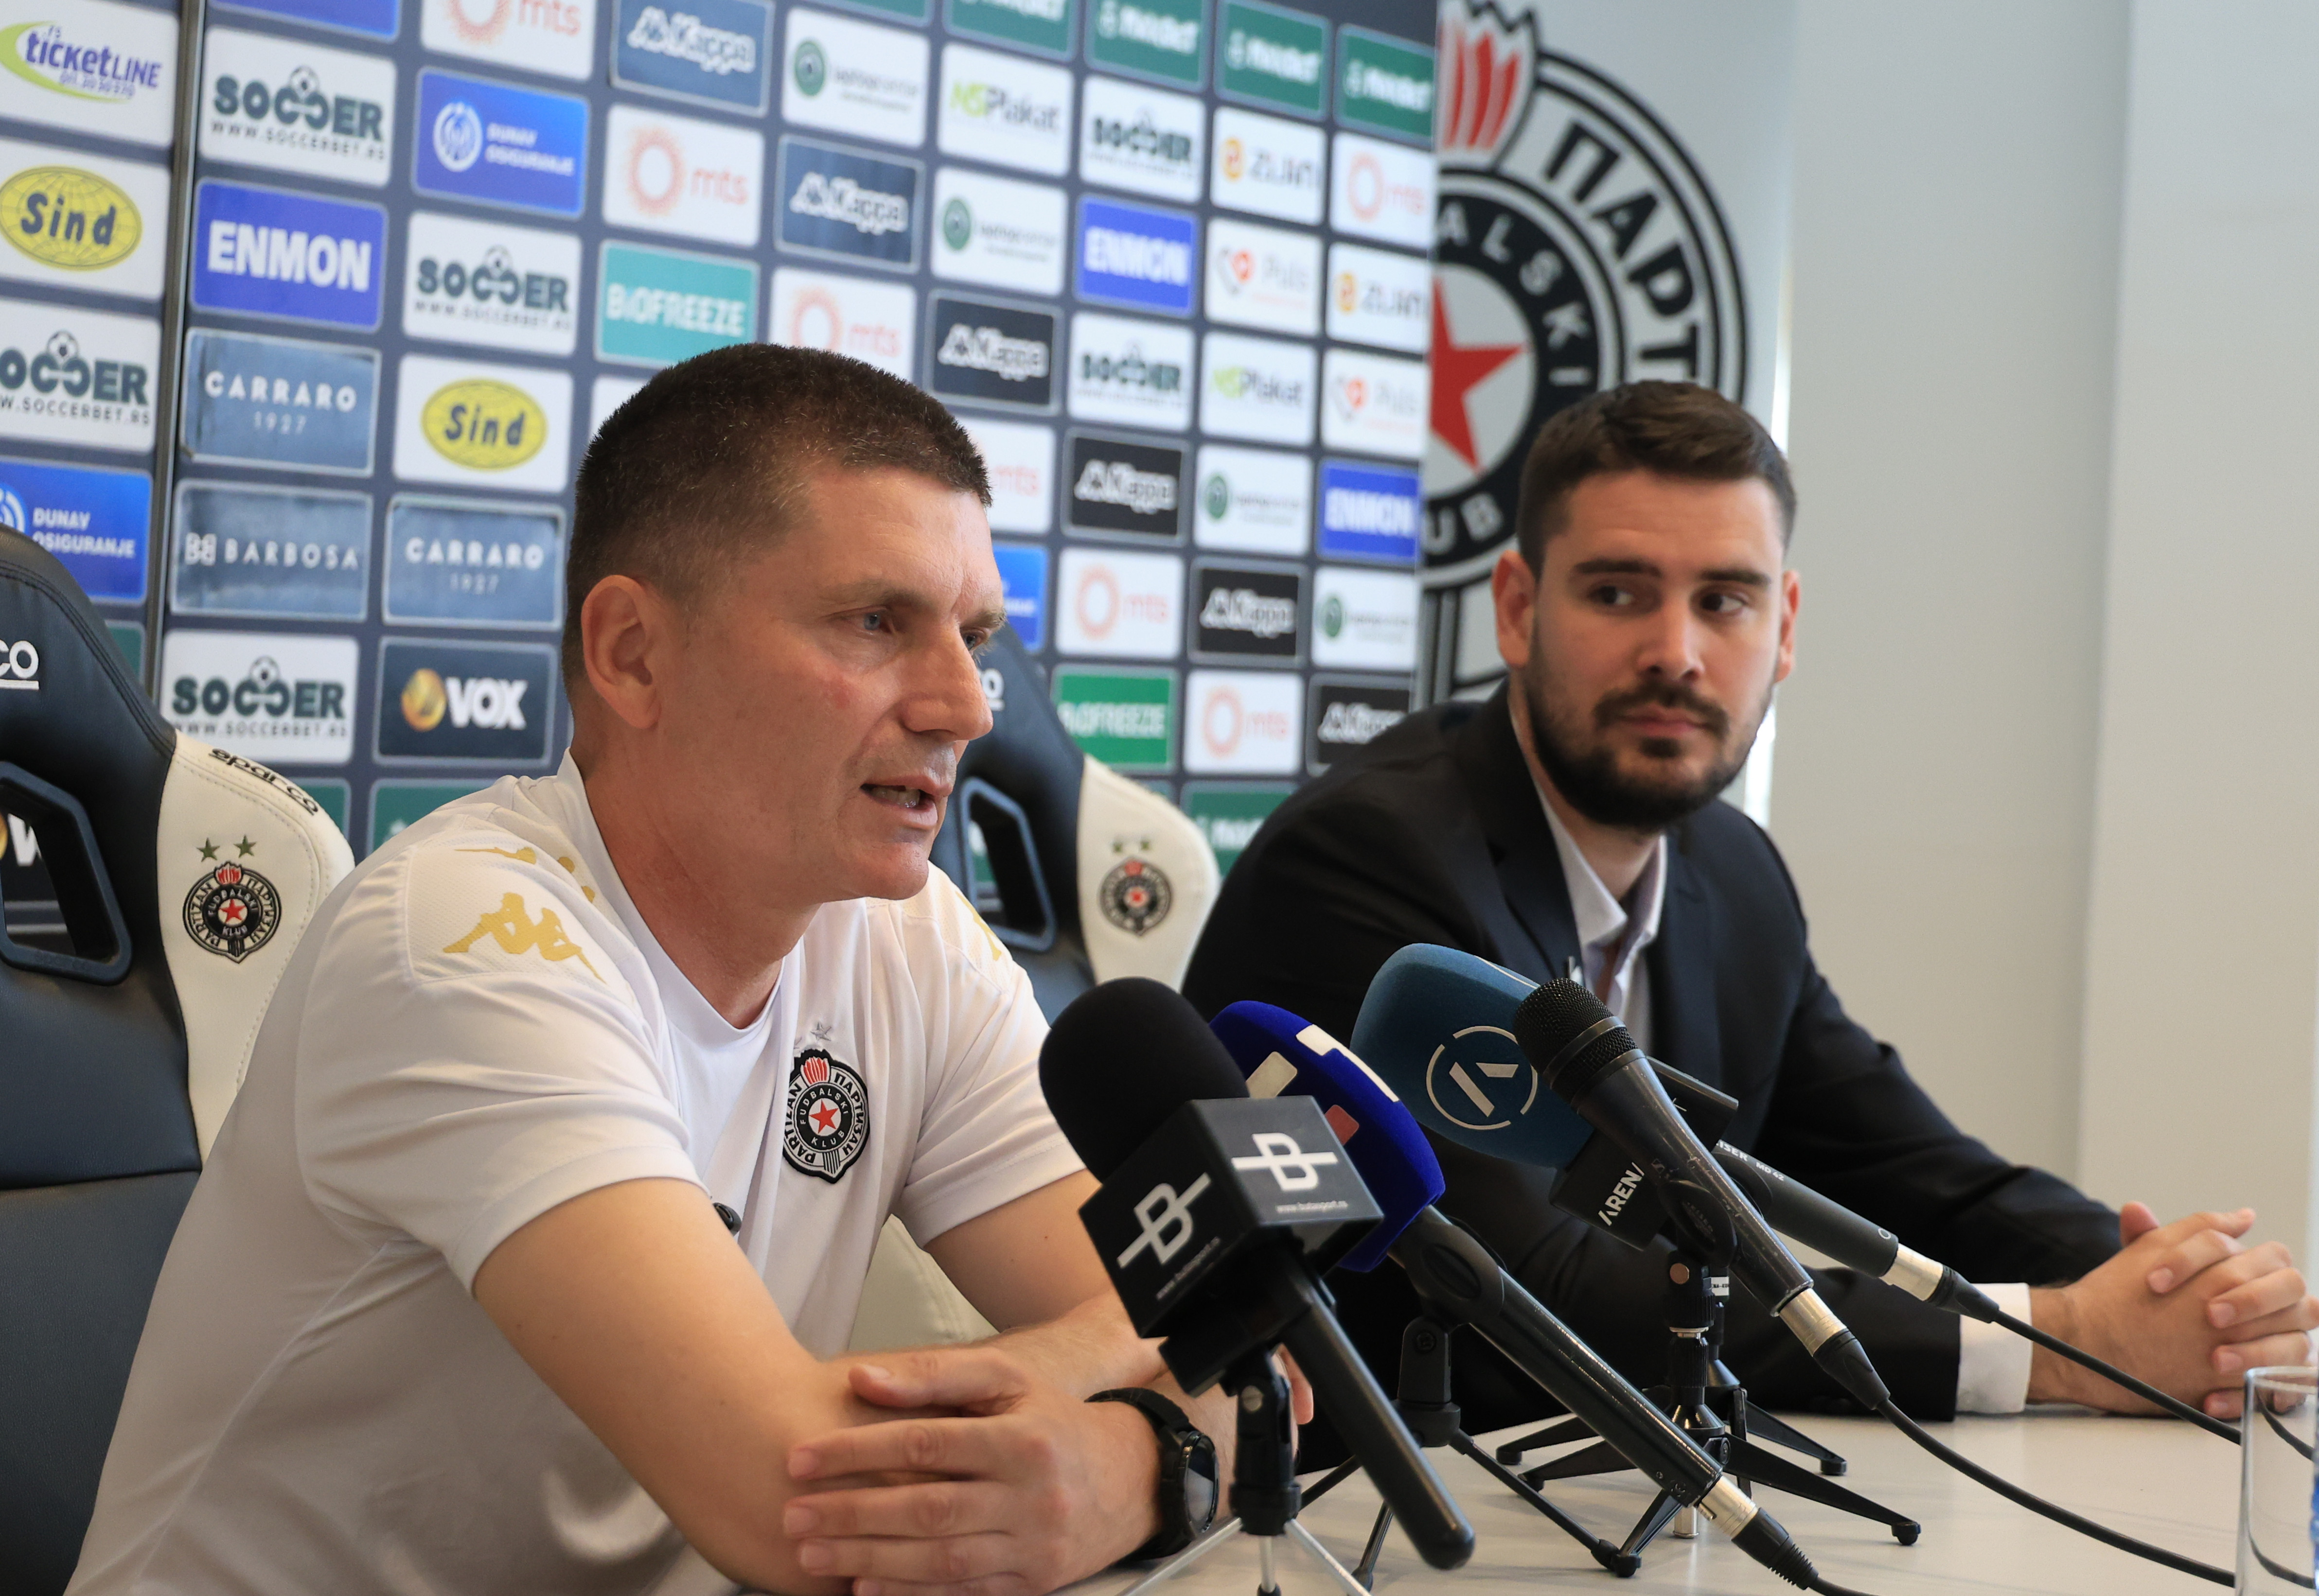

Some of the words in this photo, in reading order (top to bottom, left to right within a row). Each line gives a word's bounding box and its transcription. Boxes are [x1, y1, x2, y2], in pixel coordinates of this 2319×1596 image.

[519, 0, 582, 37] mts
[27, 31, 161, 88] ticketLINE
[213, 74, 383, 141] SOCCER
[691, 167, 748, 205] mts
[20, 193, 117, 247] Sind
[208, 220, 372, 292] ENMON
[1544, 122, 1698, 378] ПАРТ
[418, 258, 568, 313] SOCCER
[1437, 200, 1592, 386] ALSKI
[0, 349, 148, 405] OCCER
[204, 370, 357, 413] CARRARO
[253, 411, 308, 436] 1927
[444, 403, 525, 447] Sind
[33, 507, 91, 531] DUNAV
[225, 538, 359, 570] BARBOSA
[405, 536, 544, 570] CARRARO
[173, 677, 346, 719] SOCCER
[446, 676, 528, 729] VOX
[211, 748, 318, 813] sparco
[800, 1088, 849, 1124] FUDBALSKI
[834, 1072, 865, 1156] ПАРТИЗАН
[811, 1129, 845, 1147] KLUB
[1716, 1140, 1748, 1162] ISER
[1756, 1161, 1772, 1174] MD
